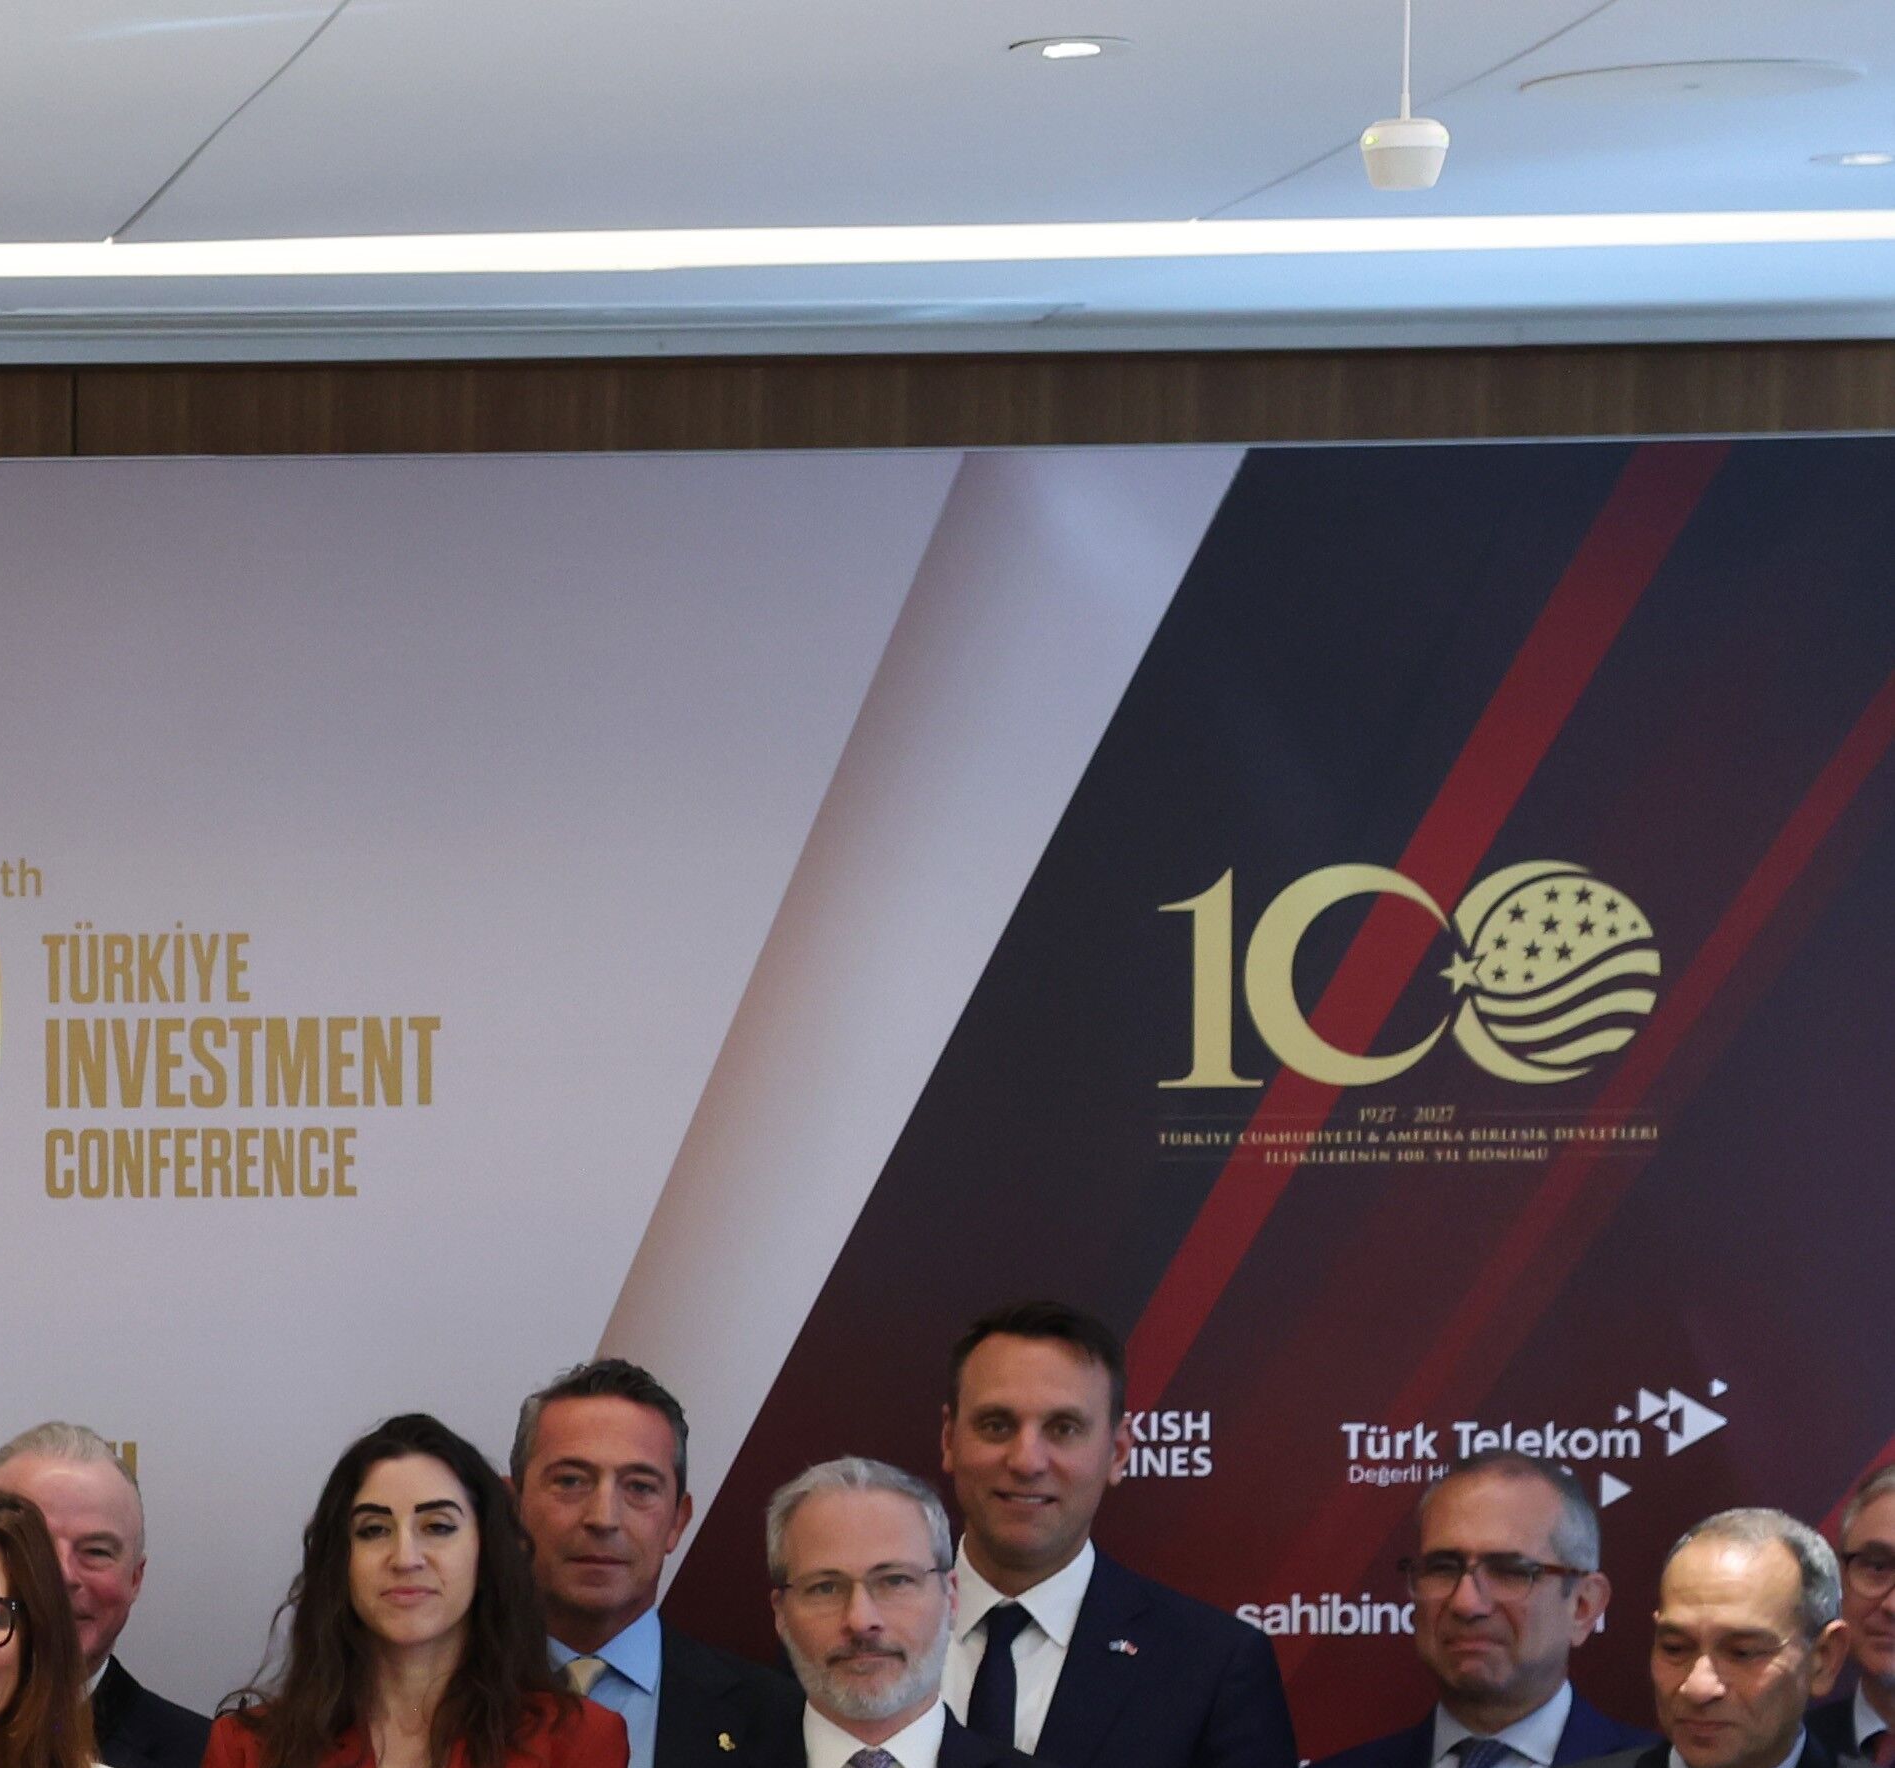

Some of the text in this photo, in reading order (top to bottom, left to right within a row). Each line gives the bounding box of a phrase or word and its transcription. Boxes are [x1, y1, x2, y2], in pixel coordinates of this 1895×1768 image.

[43, 922, 251, 1003] TÜRKİYE
[45, 1017, 440, 1108] INVESTMENT
[44, 1128, 357, 1199] CONFERENCE
[1340, 1420, 1641, 1460] Türk Telekom
[1348, 1464, 1422, 1488] Değerli
